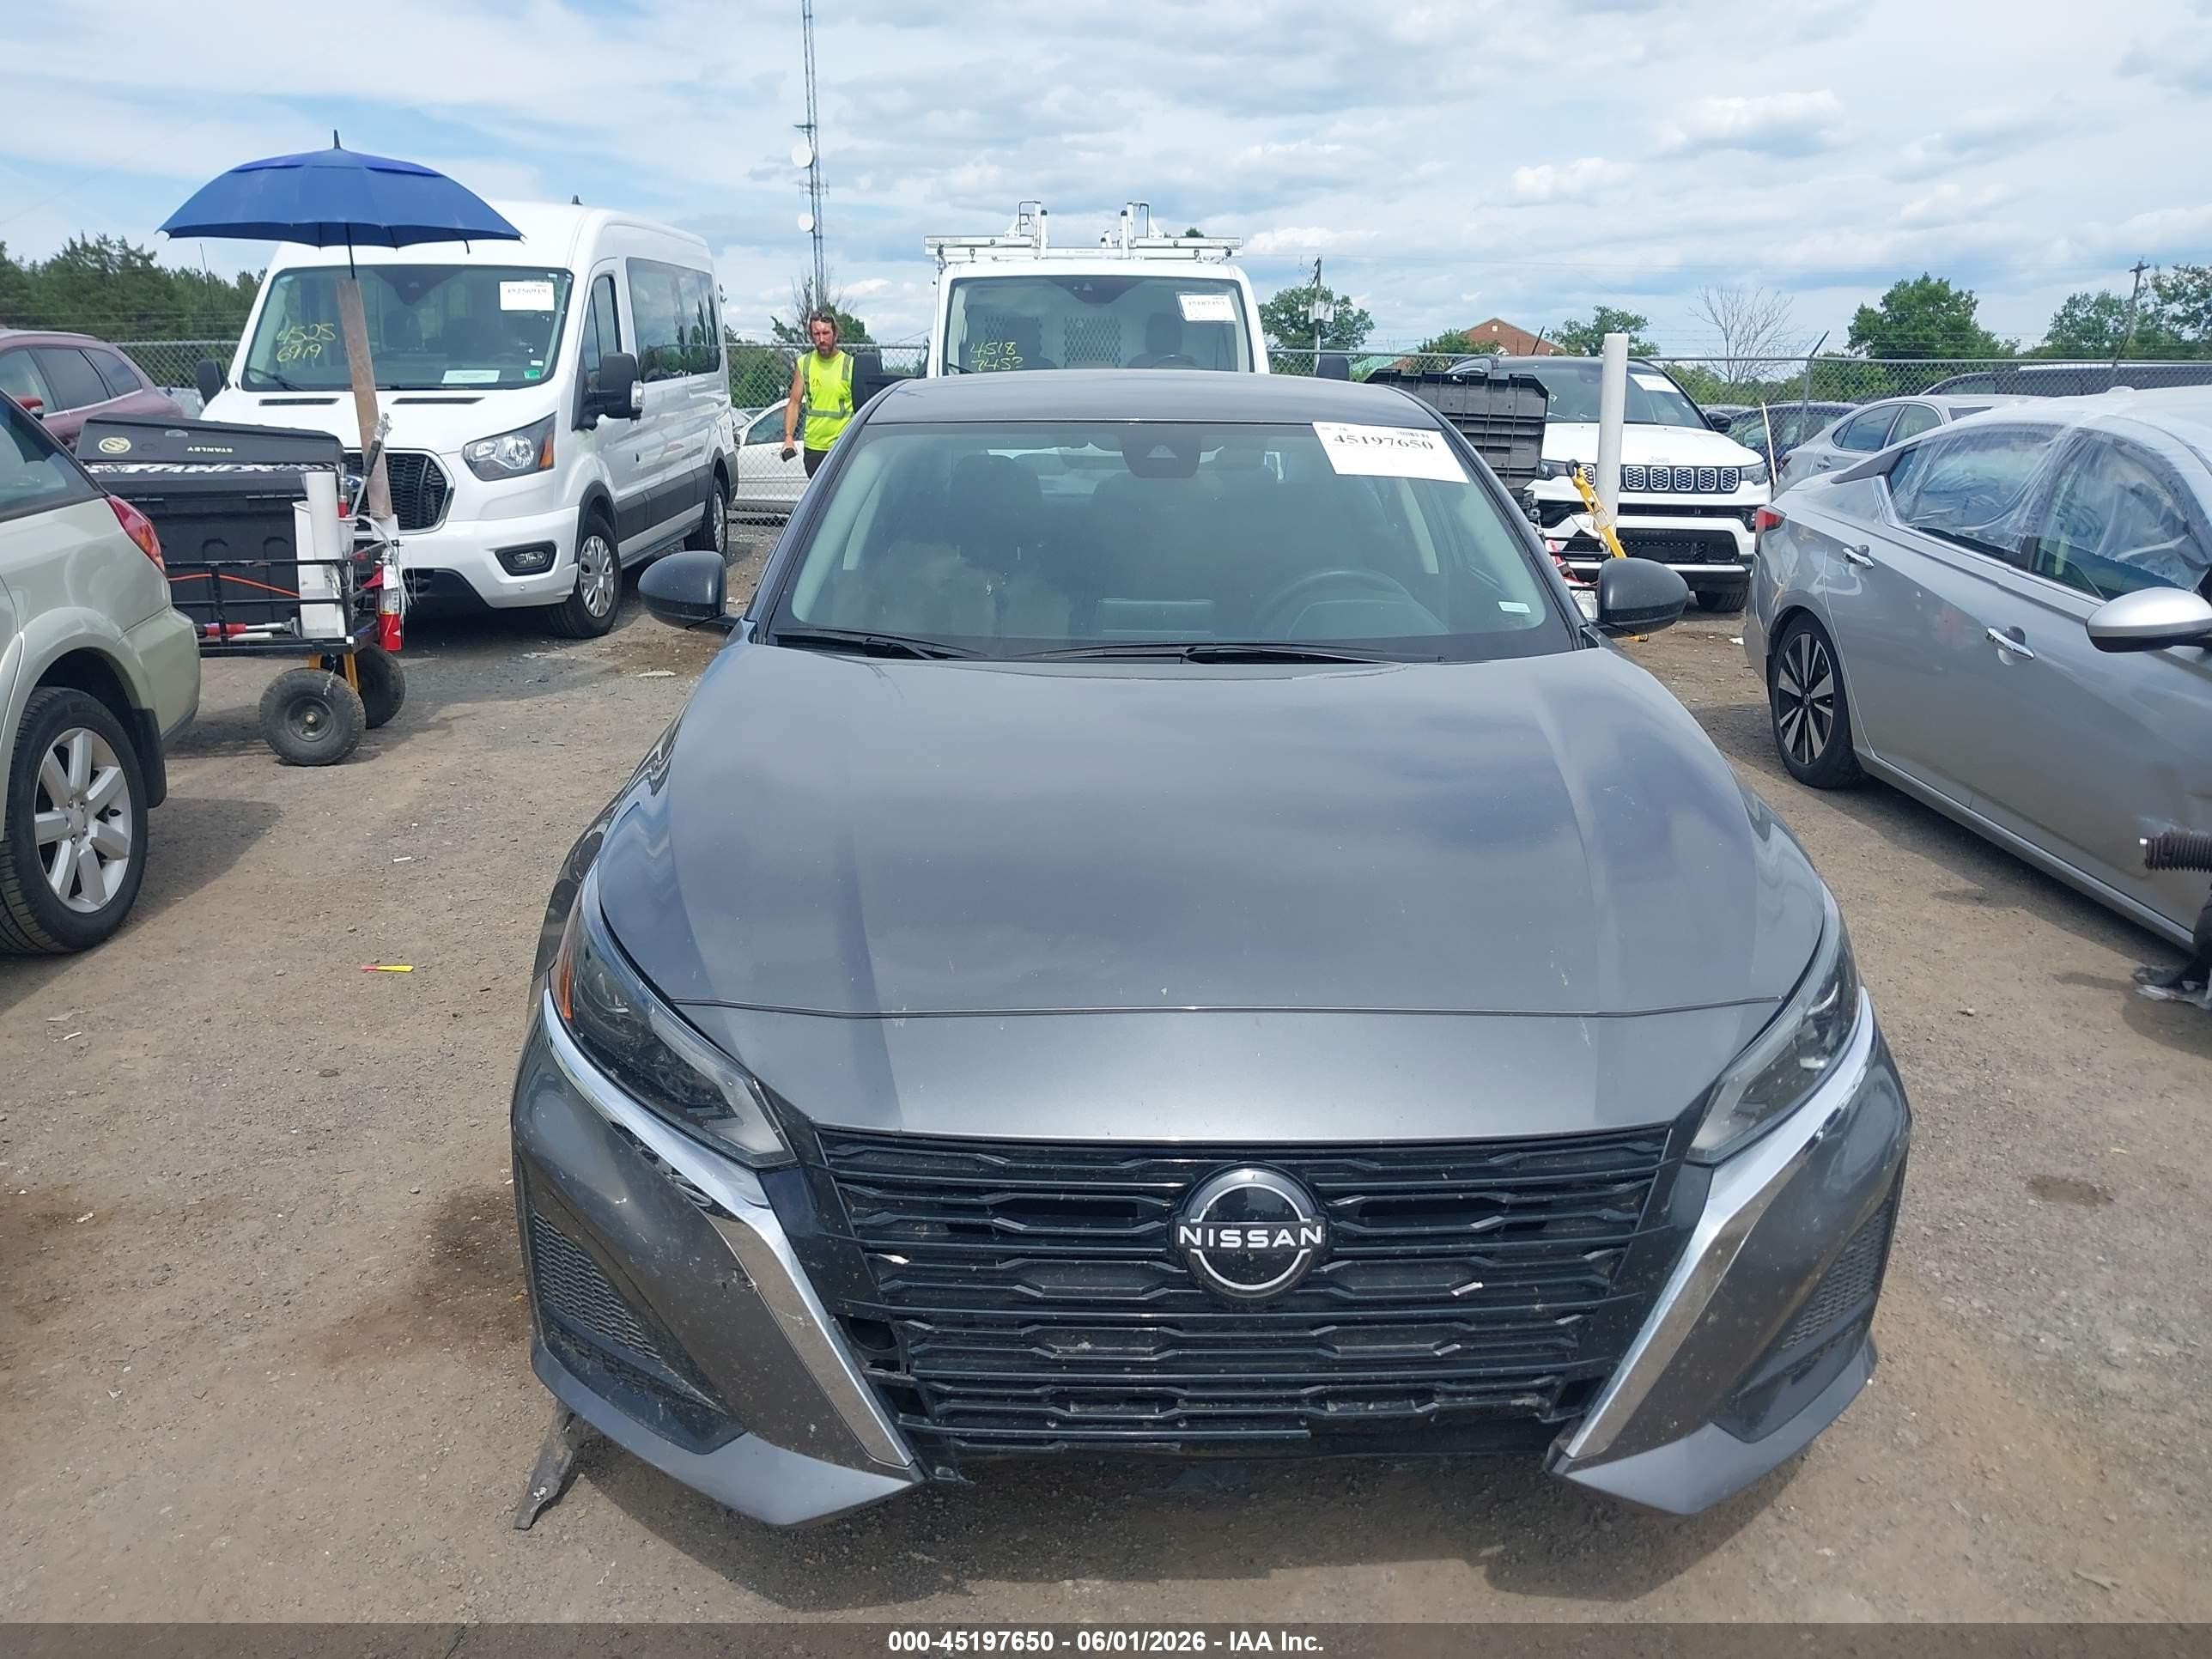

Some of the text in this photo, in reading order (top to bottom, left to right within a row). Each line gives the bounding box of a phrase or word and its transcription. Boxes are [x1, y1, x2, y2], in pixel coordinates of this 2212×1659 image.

[276, 323, 336, 343] 4525
[276, 343, 322, 362] 6919
[969, 341, 1017, 358] 4518
[1334, 434, 1434, 450] 45197650
[1179, 1224, 1322, 1249] NISSAN
